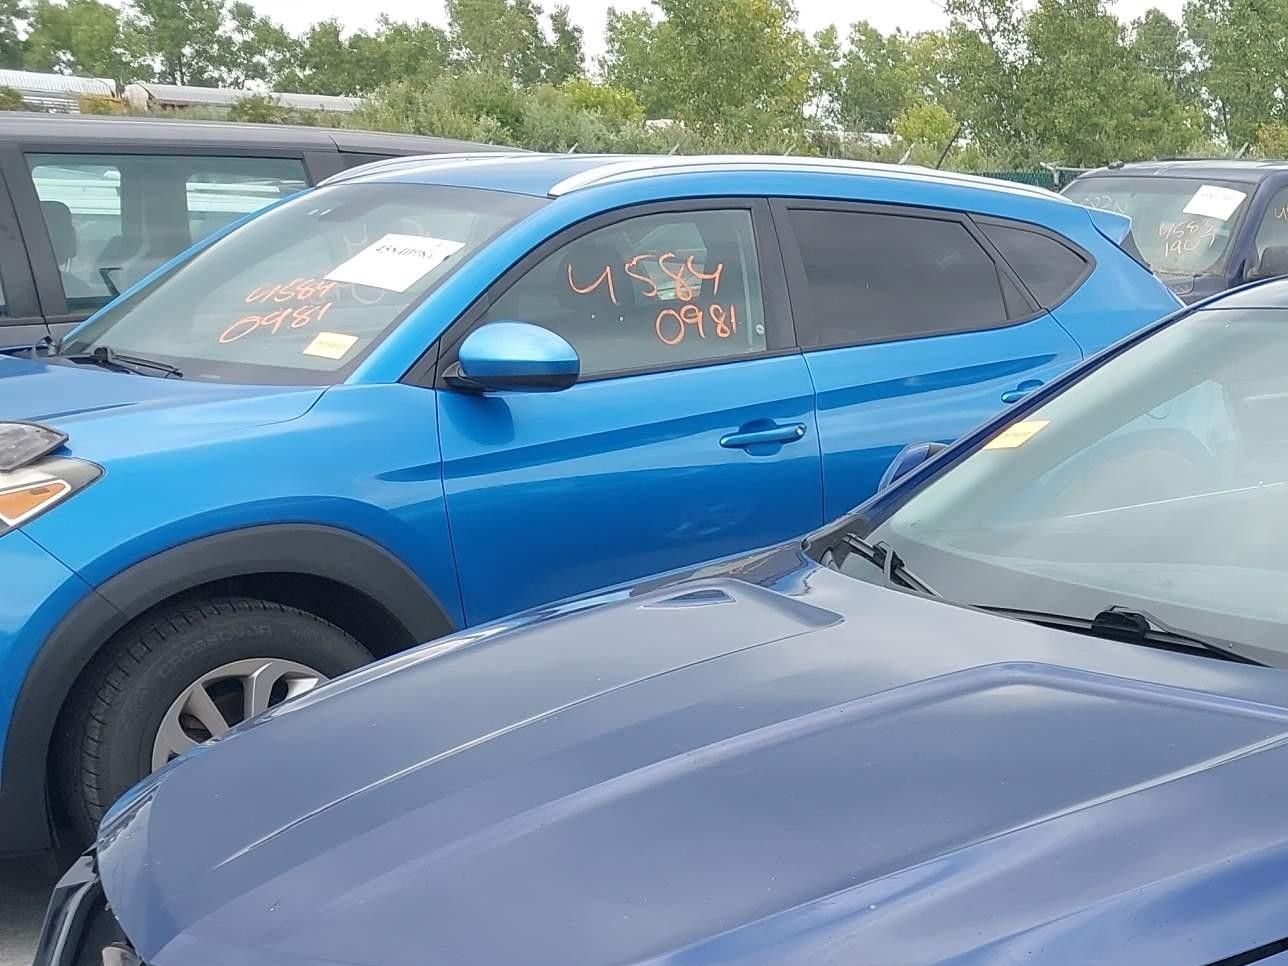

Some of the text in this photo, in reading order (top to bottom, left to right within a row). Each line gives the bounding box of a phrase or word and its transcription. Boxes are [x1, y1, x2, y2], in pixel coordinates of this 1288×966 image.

[245, 278, 338, 303] 4584
[567, 252, 723, 305] 4584
[219, 302, 332, 343] 0981
[655, 304, 737, 345] 0981
